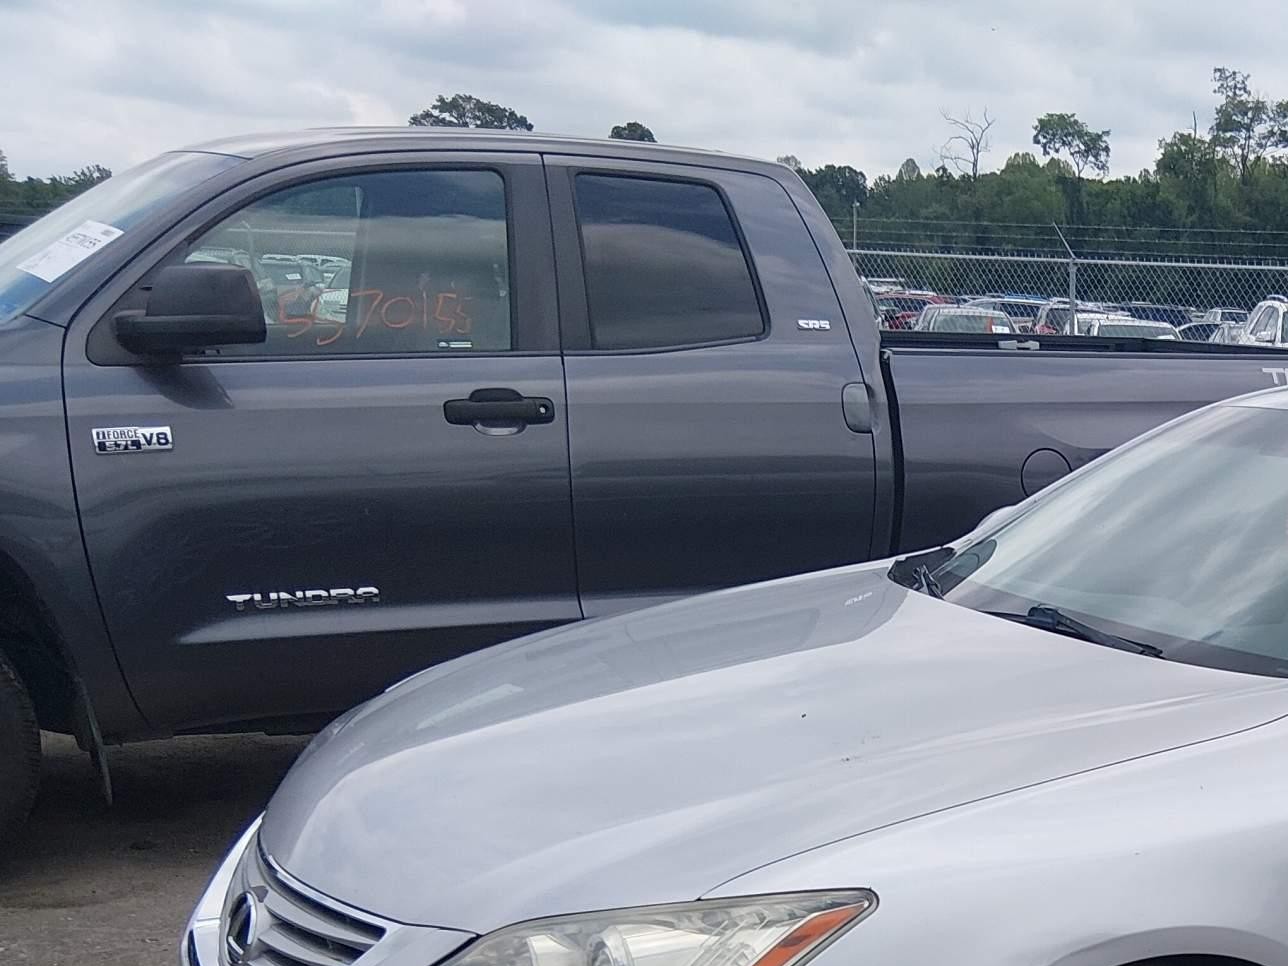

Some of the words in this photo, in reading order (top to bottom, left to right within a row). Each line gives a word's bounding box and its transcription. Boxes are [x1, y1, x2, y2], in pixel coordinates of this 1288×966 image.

[798, 319, 831, 330] SR5
[141, 432, 170, 447] V8
[226, 586, 380, 611] TUNDRA
